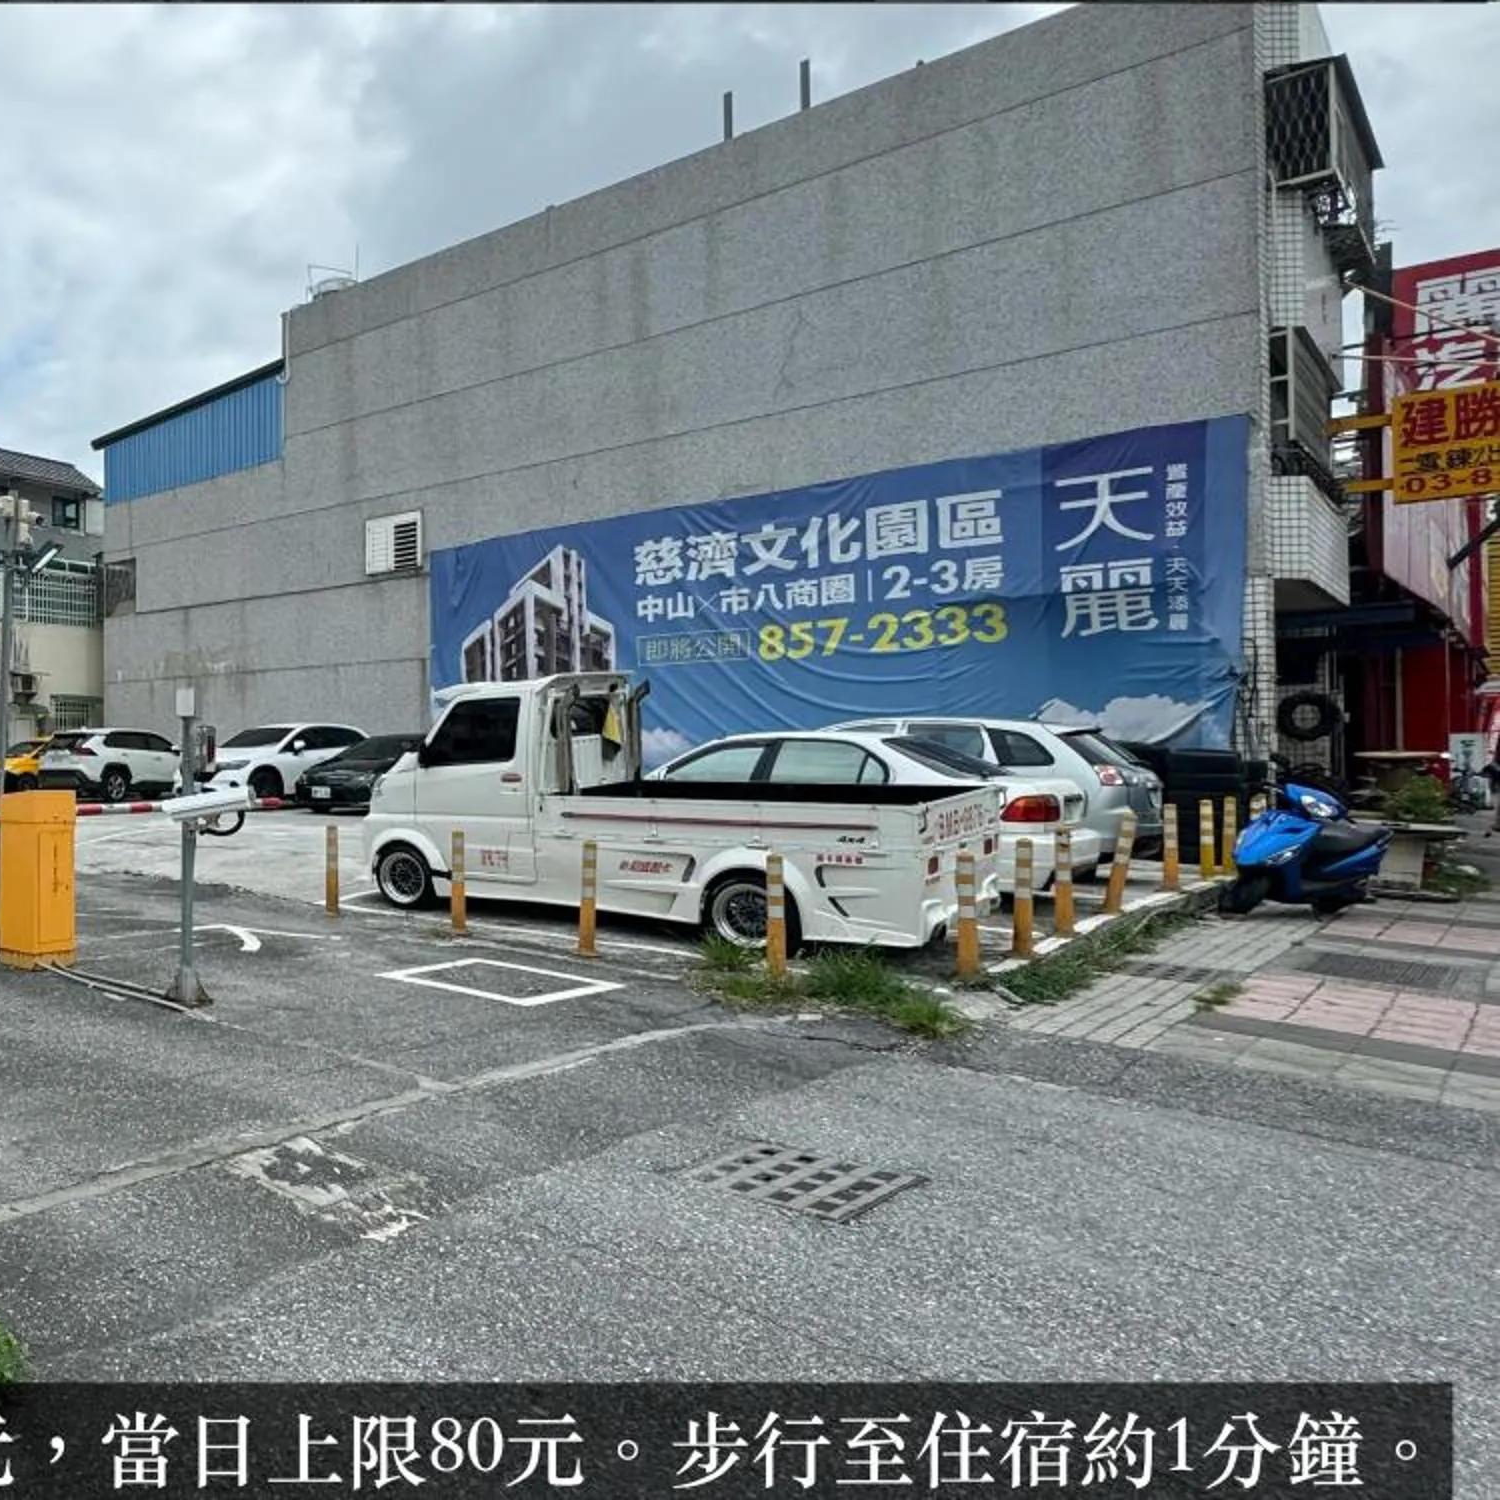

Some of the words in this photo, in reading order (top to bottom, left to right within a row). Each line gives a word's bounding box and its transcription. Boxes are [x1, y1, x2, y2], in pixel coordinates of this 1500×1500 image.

[634, 489, 1004, 587] 慈濟文化園區
[1055, 466, 1159, 638] 天麗
[882, 555, 1005, 601] 2-3房
[756, 603, 1009, 662] 857-2333
